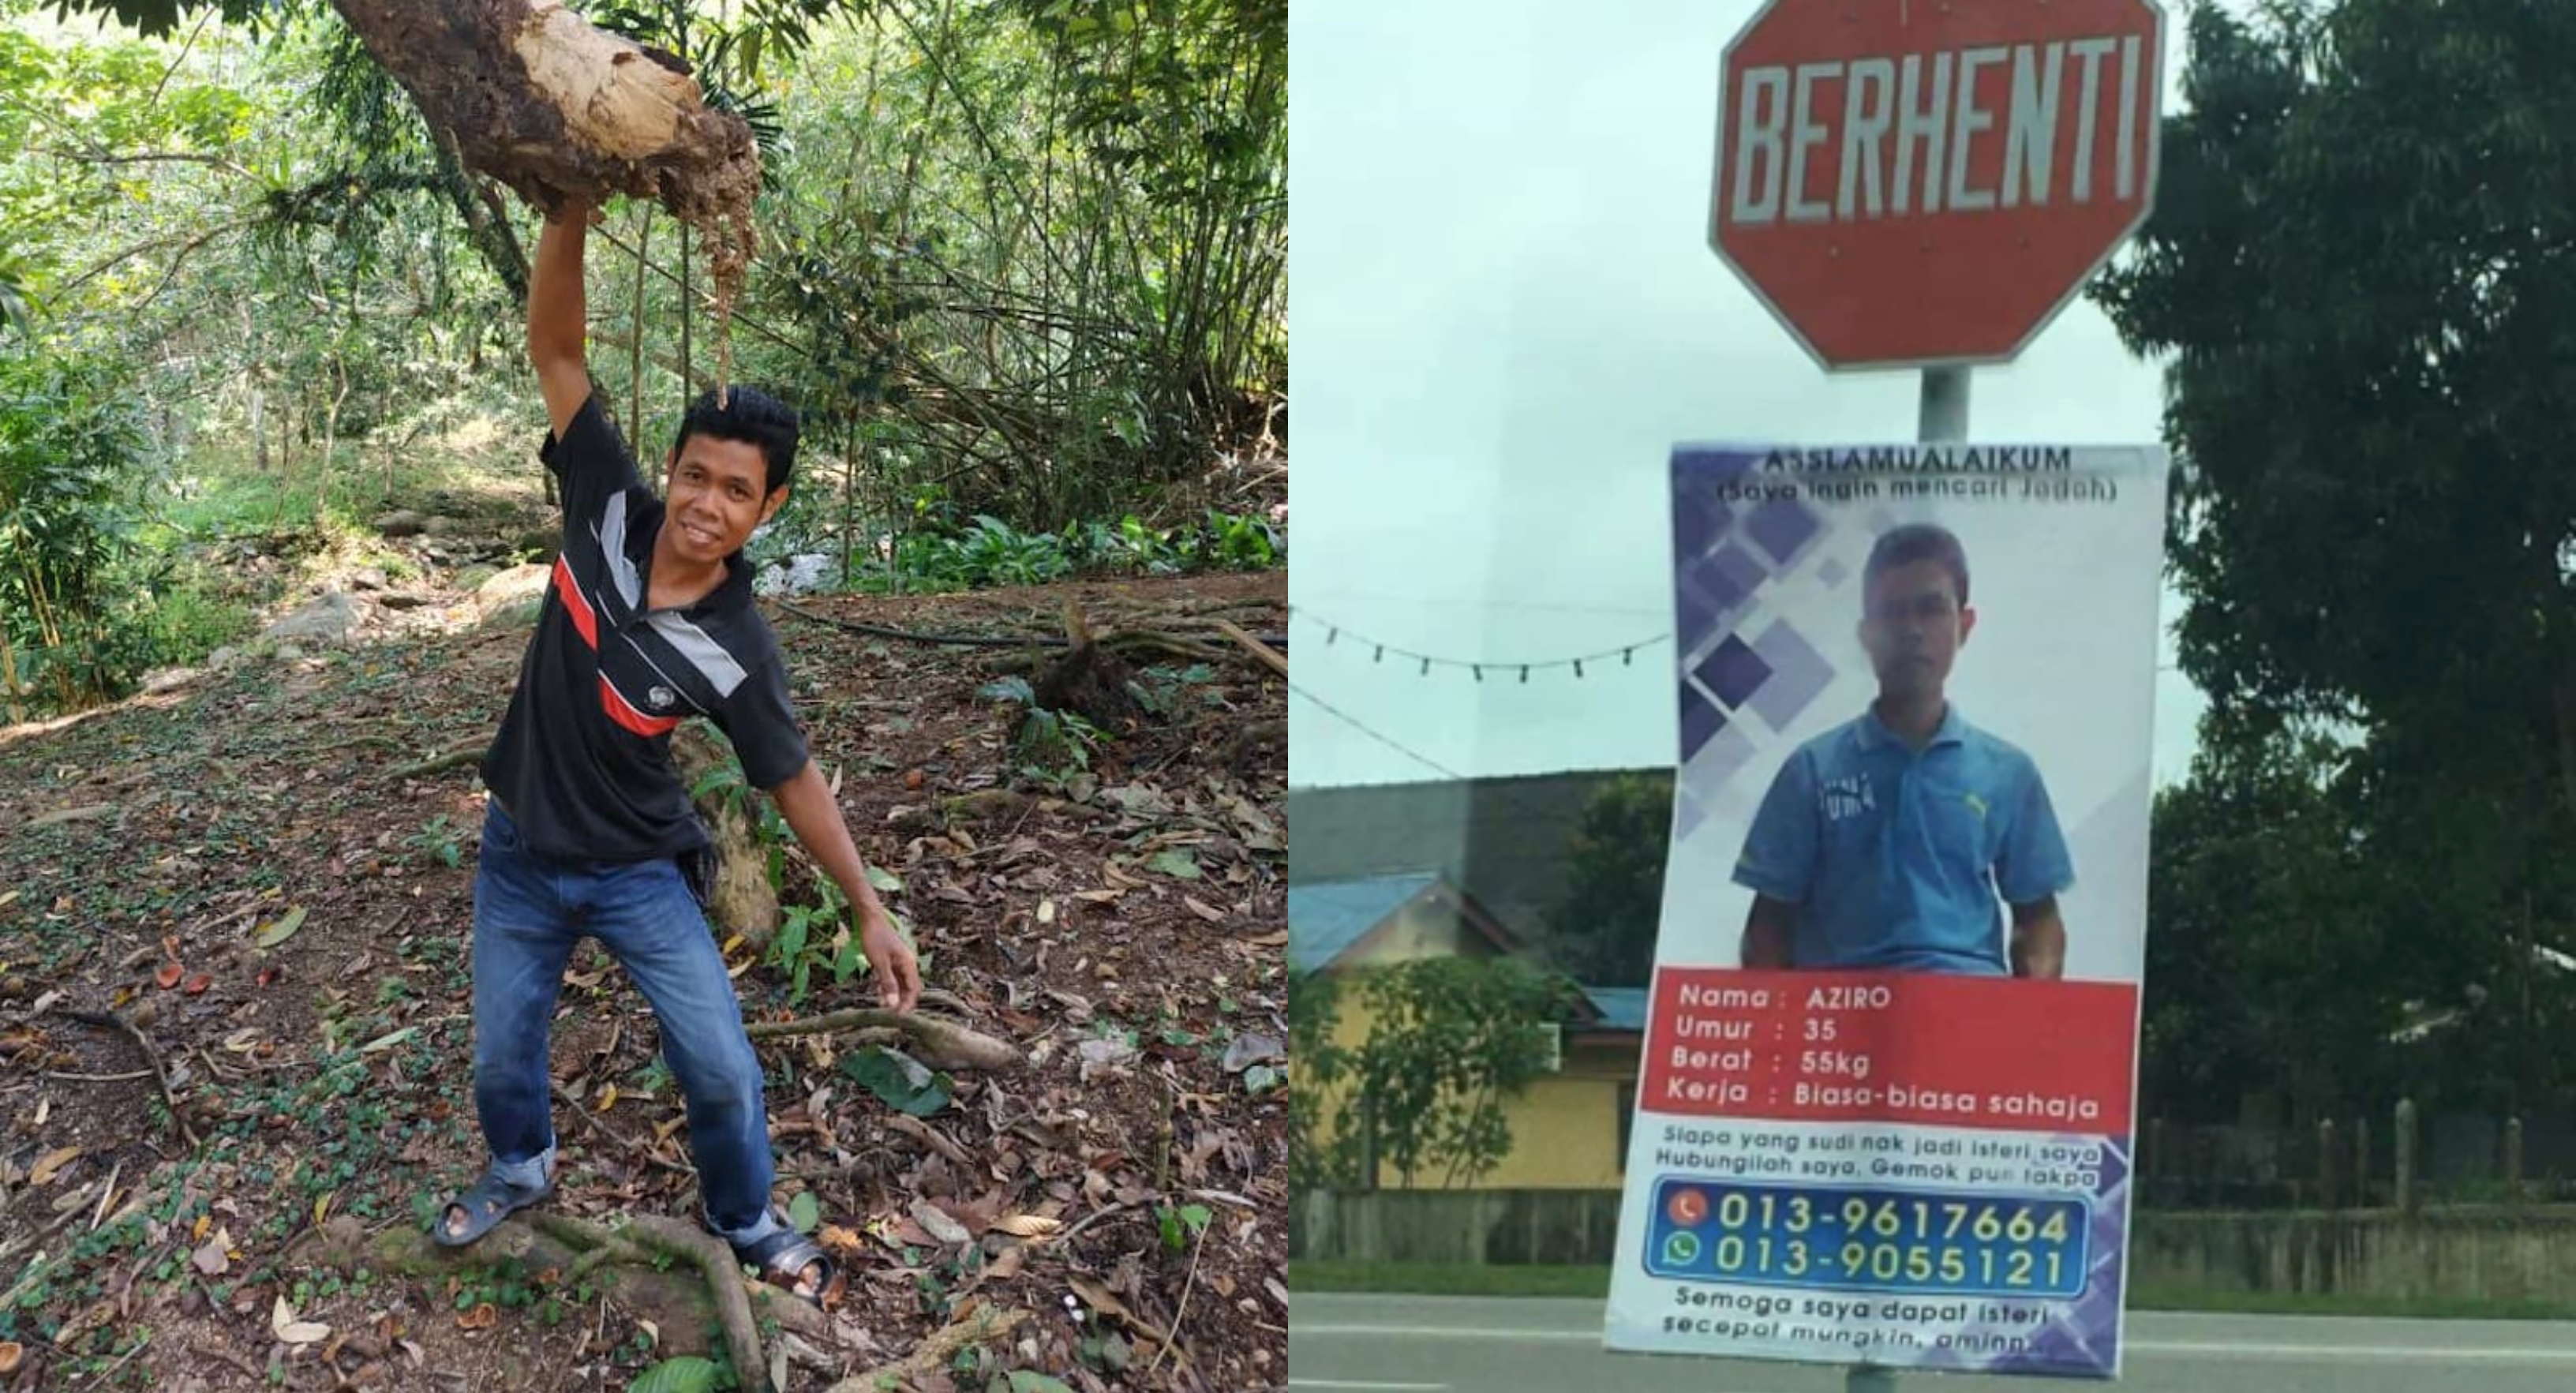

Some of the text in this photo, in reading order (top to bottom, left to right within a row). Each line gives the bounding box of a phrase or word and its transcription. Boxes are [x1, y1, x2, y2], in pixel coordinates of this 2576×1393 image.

[1732, 35, 2141, 223] BERHENTI
[1889, 476, 2008, 500] mencari
[1679, 984, 1770, 1009] Nama
[1805, 986, 1892, 1009] AZIRO
[1676, 1015, 1754, 1040] Umur
[1803, 1018, 1837, 1041] 35
[1671, 1046, 1753, 1072] Berat
[1800, 1050, 1870, 1079] 55kg
[1667, 1077, 1750, 1106] Kerja
[1793, 1082, 1975, 1114] Biasa-biasa
[1986, 1092, 2100, 1120] sahaja
[1663, 1124, 1732, 1145] Siapa
[1740, 1132, 1800, 1153] yang
[1808, 1133, 1855, 1151] sudi
[1861, 1133, 1904, 1153] nak
[1913, 1136, 1962, 1157] jadi
[2039, 1146, 2100, 1164] saya
[1656, 1148, 1792, 1174] Hubungilah
[1870, 1157, 1959, 1181] Gemok
[2024, 1167, 2098, 1188] takpa
[1719, 1193, 2071, 1245] 013-9617664
[1717, 1236, 2063, 1288] 013-9055121
[1675, 1286, 2048, 1326] Semoga saya dapat isteri
[1663, 1315, 1780, 1340] secepat
